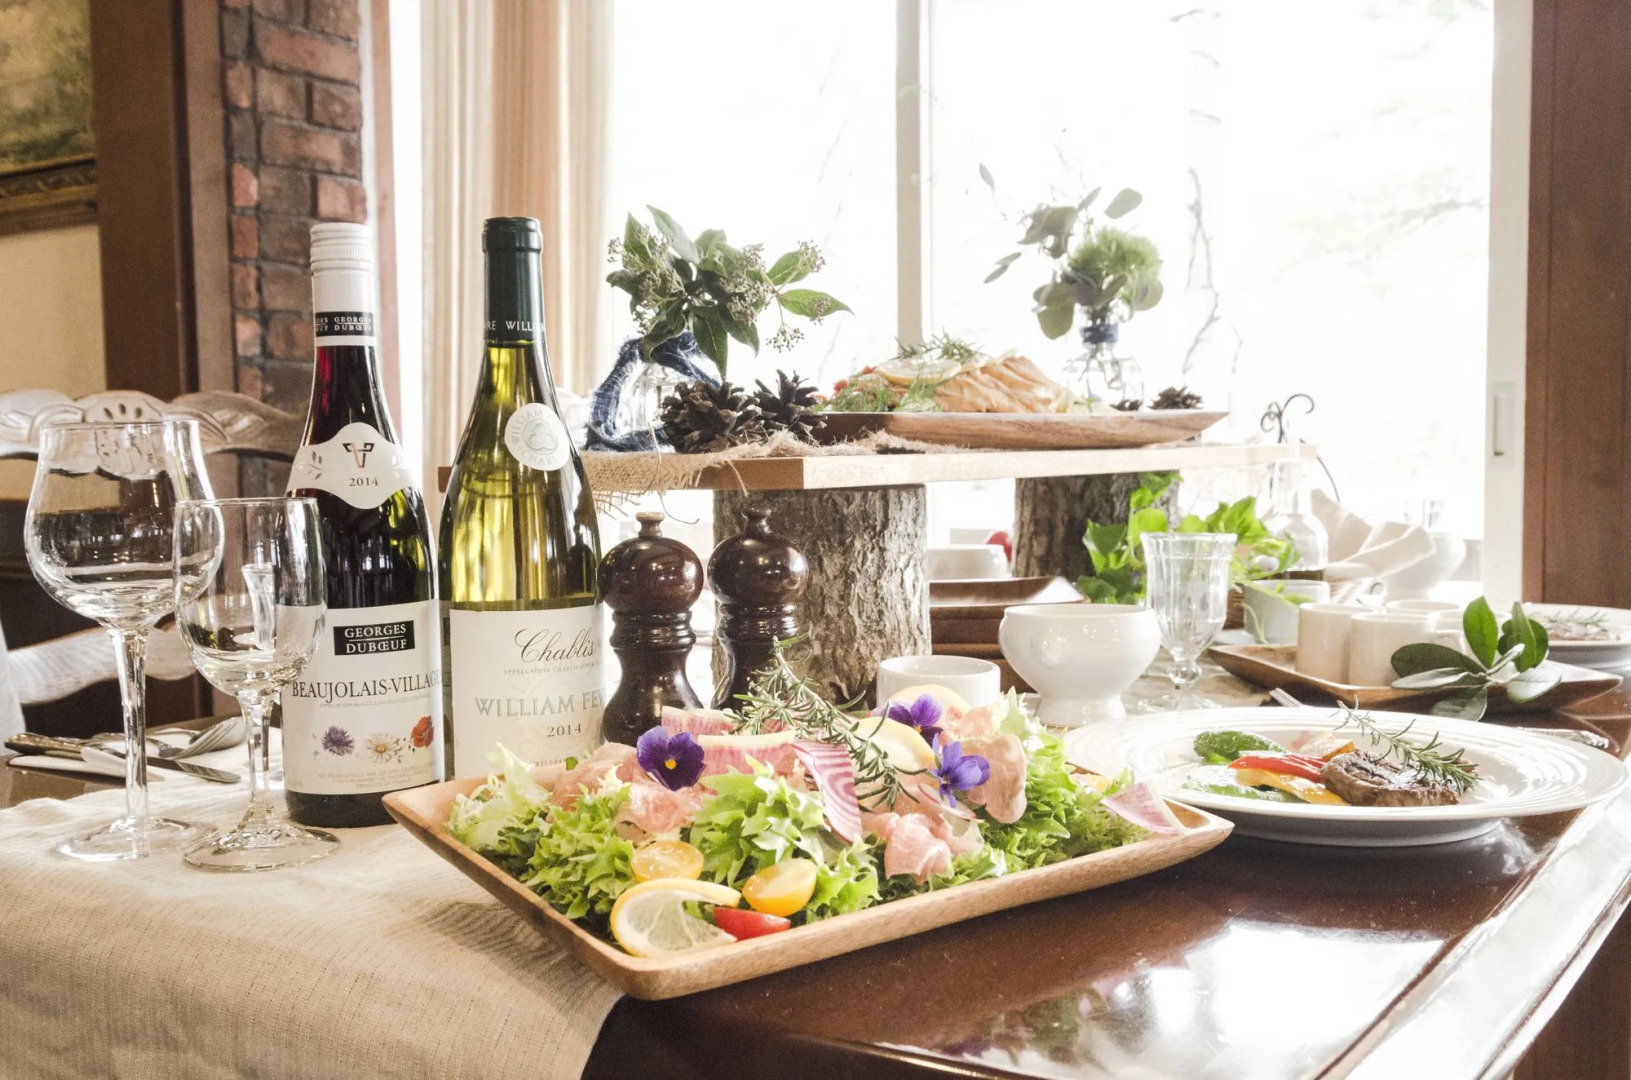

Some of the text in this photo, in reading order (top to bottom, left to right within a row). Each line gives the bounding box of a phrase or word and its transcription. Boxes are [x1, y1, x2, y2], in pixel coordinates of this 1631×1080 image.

[505, 320, 543, 331] WILL
[348, 477, 379, 487] 2014
[344, 623, 407, 638] GEORGES
[345, 638, 407, 654] DUBŒUF
[514, 626, 596, 663] Chablis
[474, 694, 576, 717] WILLIAM
[546, 722, 582, 738] 2014
[533, 758, 567, 767] WILLIA
